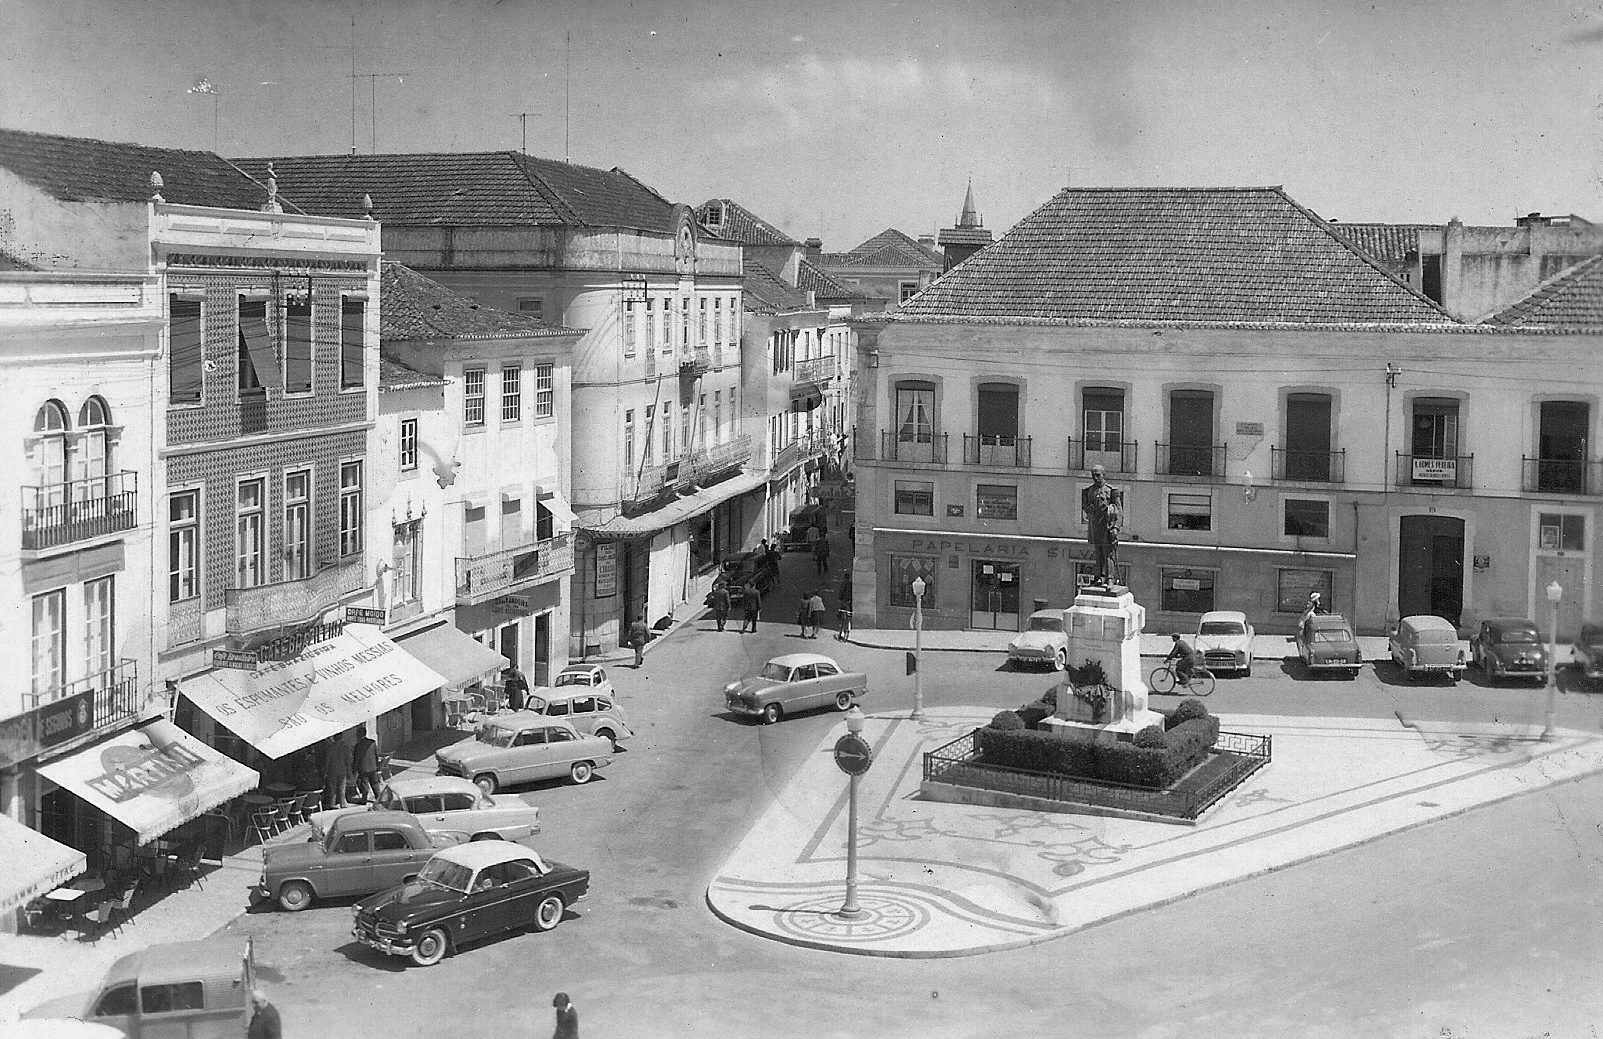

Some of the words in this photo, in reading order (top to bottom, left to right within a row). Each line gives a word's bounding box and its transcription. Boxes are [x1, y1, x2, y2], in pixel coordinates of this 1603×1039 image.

[912, 539, 1030, 556] PAPELARIA
[216, 702, 237, 717] OS
[235, 676, 306, 710] ESPUMANTES
[315, 658, 356, 681] VINHOS
[351, 641, 395, 665] MESSIAS
[314, 702, 335, 715] OS
[340, 673, 403, 705] MELHORES
[91, 745, 201, 800] MARTINI
